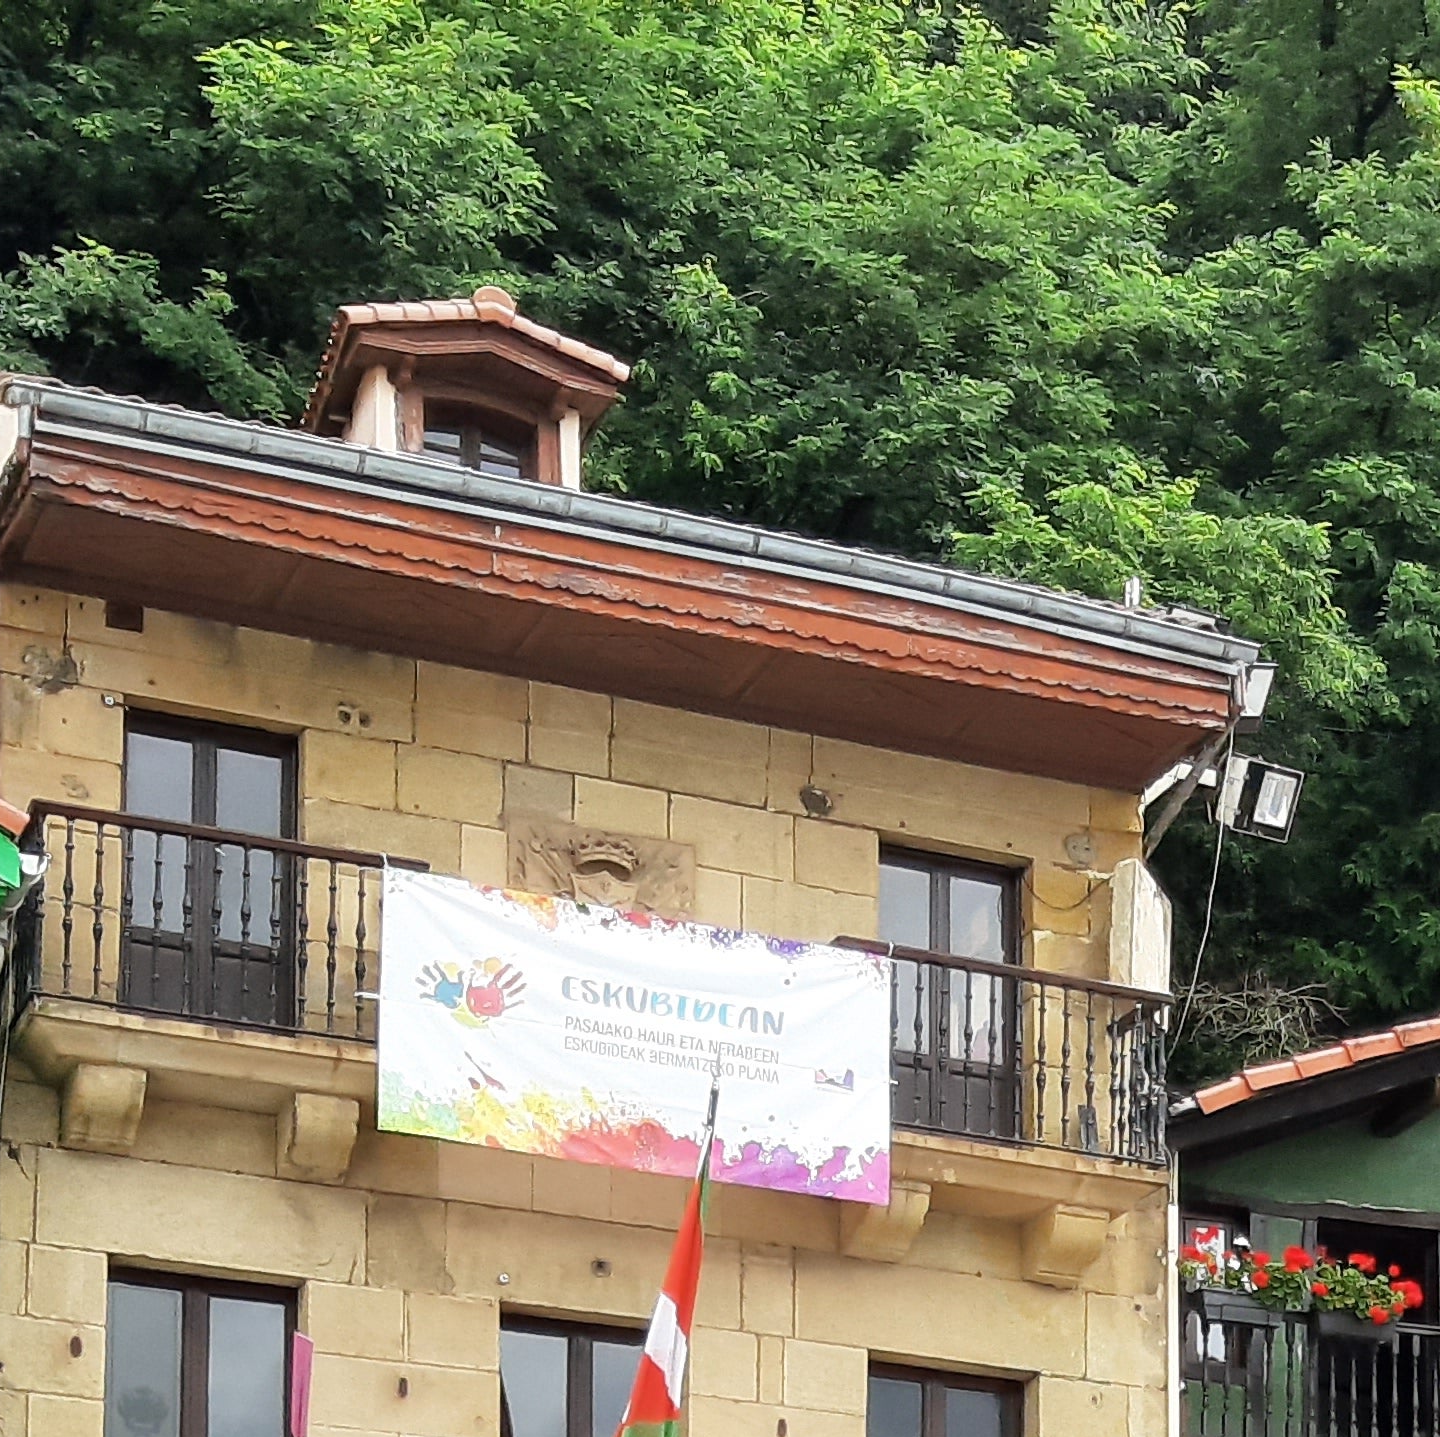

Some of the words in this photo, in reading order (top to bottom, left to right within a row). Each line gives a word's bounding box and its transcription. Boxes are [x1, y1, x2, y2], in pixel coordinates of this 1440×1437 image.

[562, 976, 784, 1035] ESKUBIDEAN
[565, 1016, 632, 1039] PASAIAKO
[638, 1028, 674, 1047] HAUR
[680, 1035, 703, 1051] ETA
[709, 1040, 779, 1064] NERABEEN
[565, 1036, 645, 1062] ESKUBIDEAK
[650, 1050, 735, 1076] BERMATZEKO
[738, 1065, 779, 1084] PLANA
